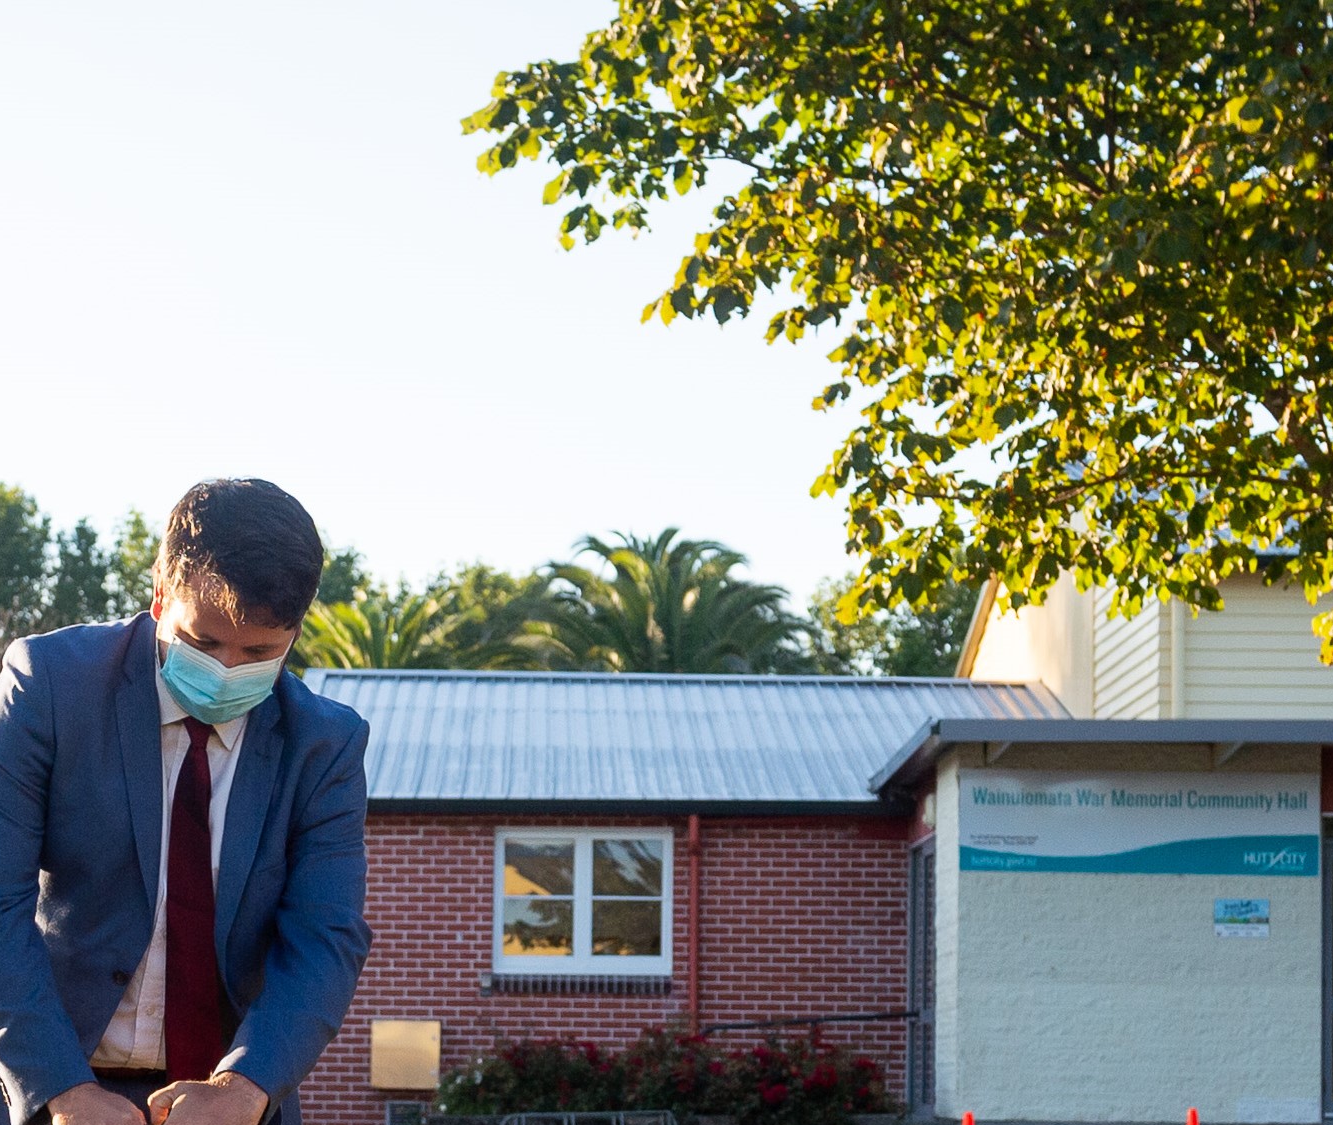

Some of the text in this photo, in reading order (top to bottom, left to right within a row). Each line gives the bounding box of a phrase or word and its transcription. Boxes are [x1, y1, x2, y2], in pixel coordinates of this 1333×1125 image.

[972, 787, 1308, 813] Wainuiomata War Memorial Community Hall
